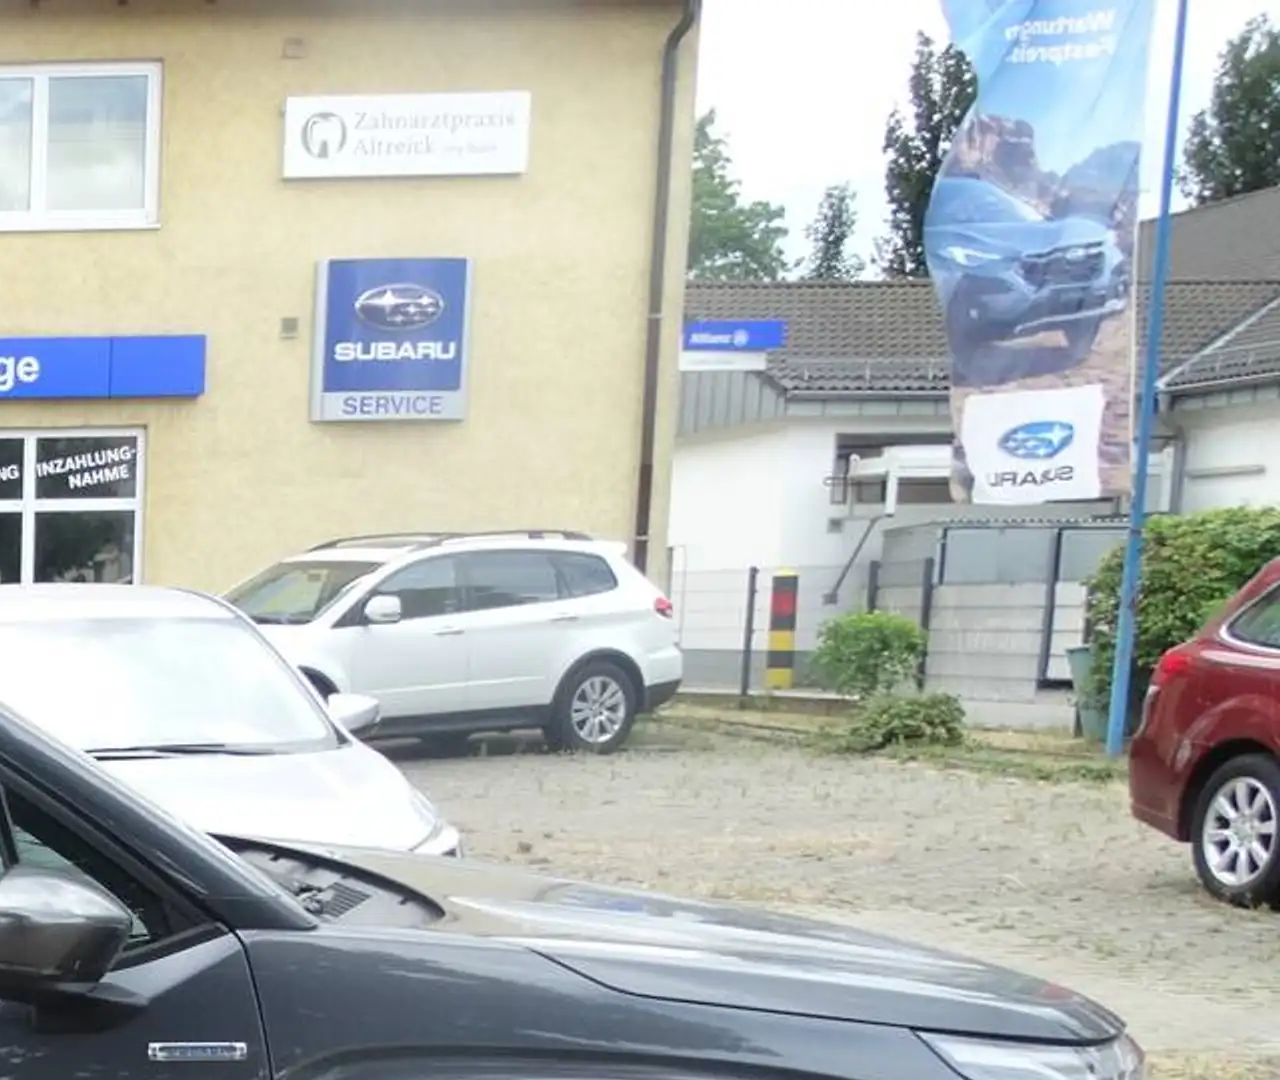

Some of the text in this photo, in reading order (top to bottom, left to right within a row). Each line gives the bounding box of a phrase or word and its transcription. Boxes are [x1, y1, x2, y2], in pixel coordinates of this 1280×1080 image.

[353, 110, 515, 134] Zahnarztpraxis
[333, 340, 456, 362] SUBARU
[341, 395, 442, 416] SERVICE
[67, 463, 130, 489] NAHME
